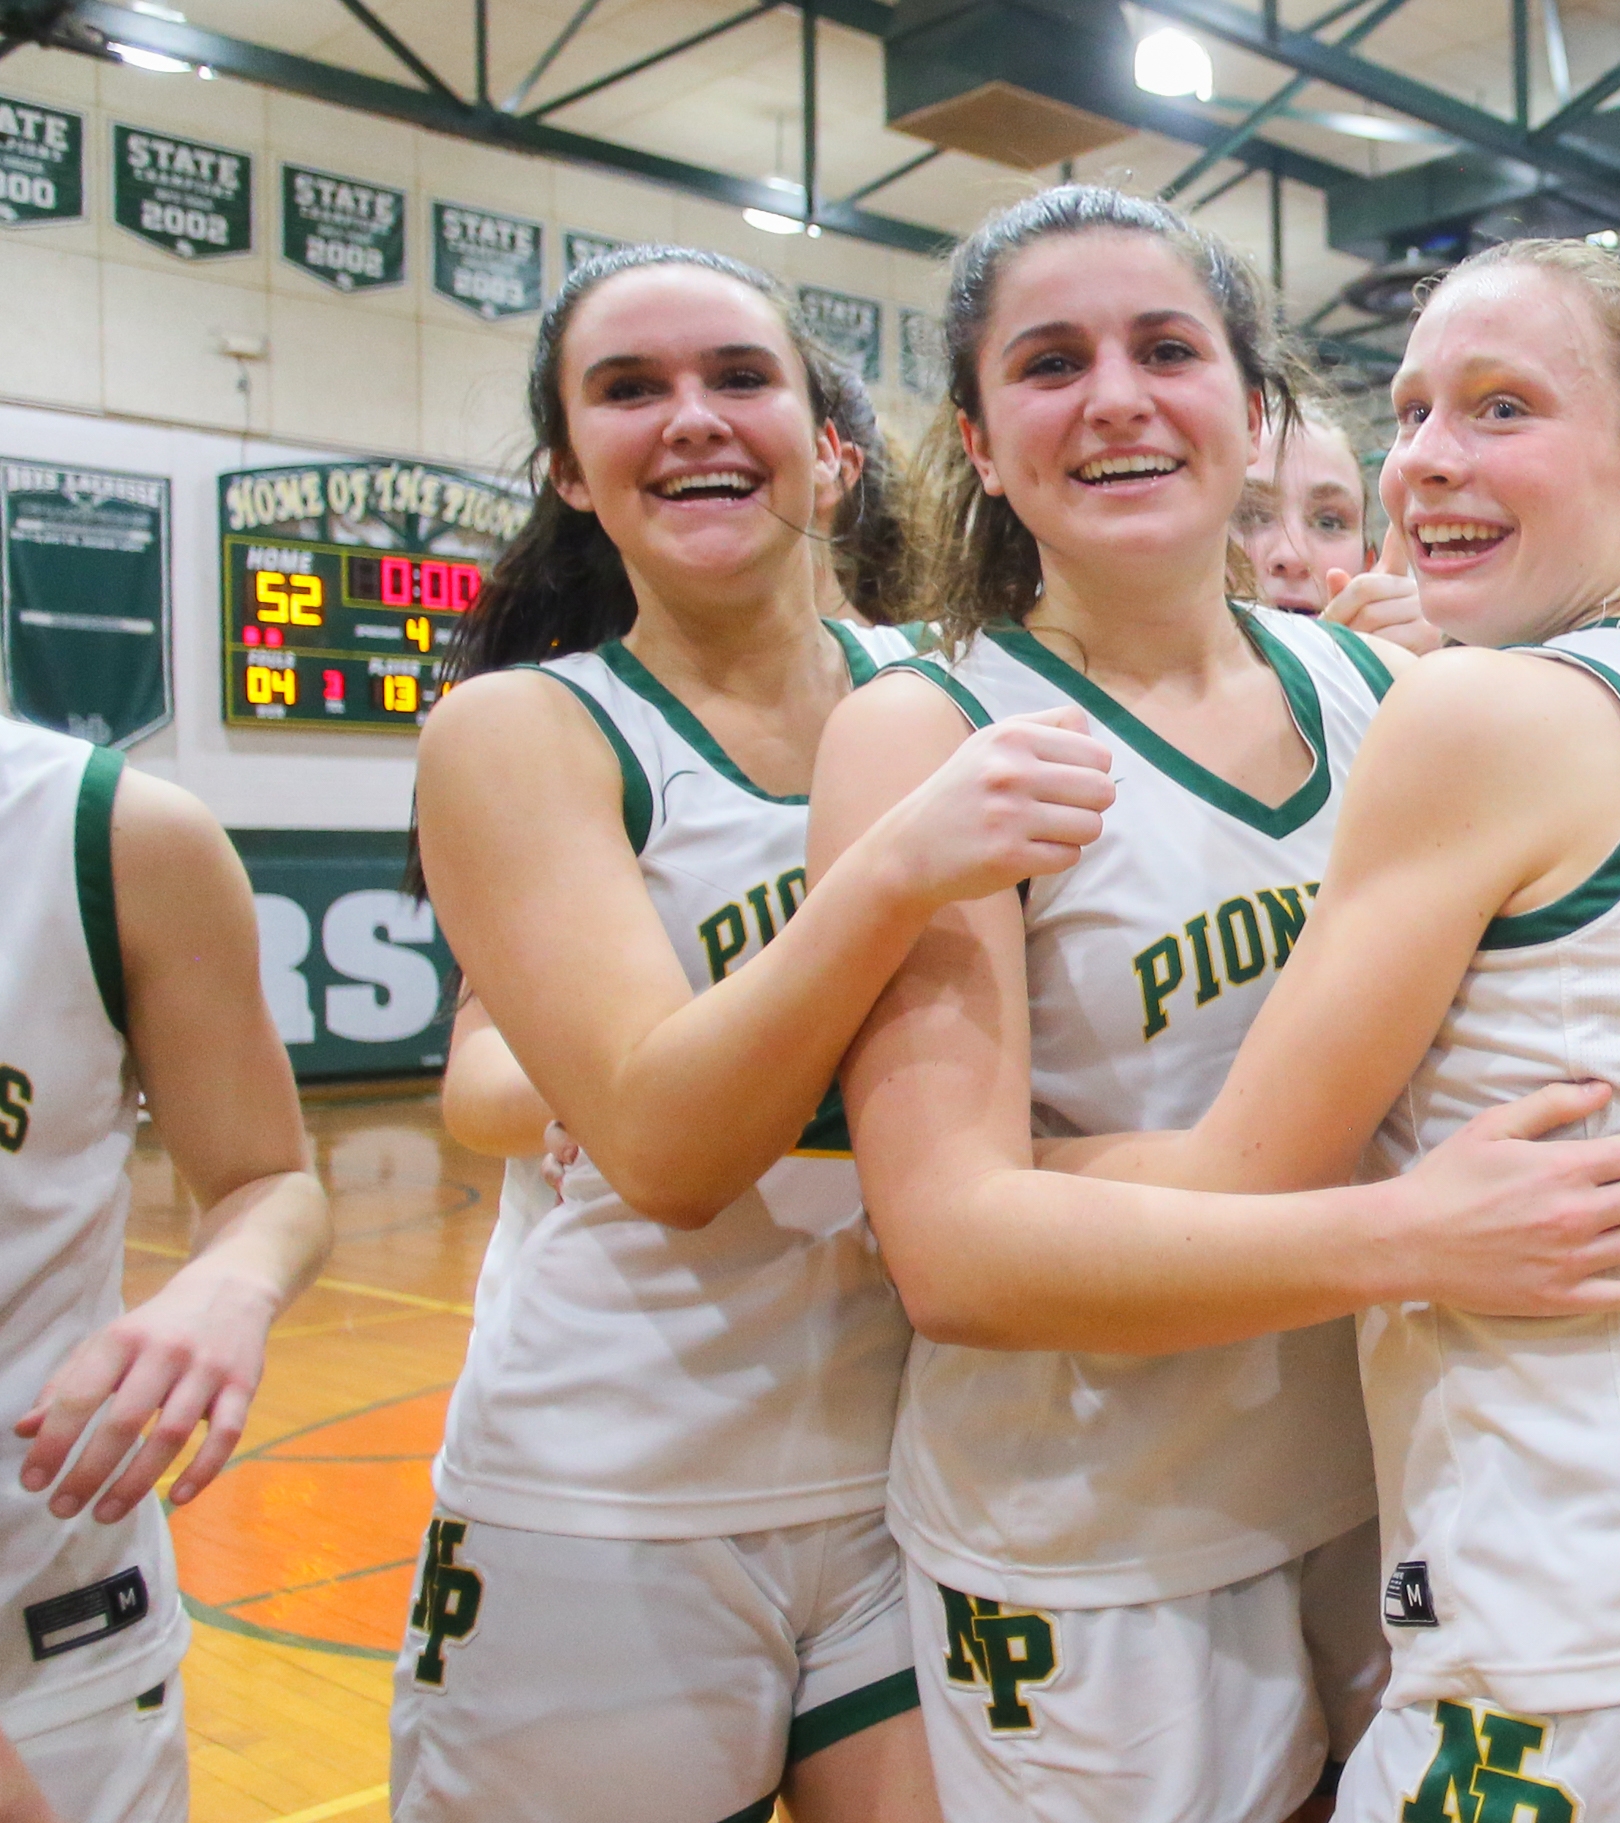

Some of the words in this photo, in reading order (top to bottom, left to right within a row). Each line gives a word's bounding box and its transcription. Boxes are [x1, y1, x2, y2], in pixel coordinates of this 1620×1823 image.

[127, 133, 240, 191] STATE
[0, 171, 57, 210] 00
[294, 172, 394, 226] STATE
[141, 199, 229, 246] 2002
[443, 208, 534, 258] STATE
[227, 471, 325, 530] HOME
[327, 468, 370, 522] OF
[374, 461, 441, 517] THE
[246, 547, 313, 574] HOME
[380, 555, 482, 612] 0:00
[255, 570, 323, 627] 52
[405, 616, 431, 653] 4
[246, 665, 296, 705] 04
[383, 674, 418, 713] 13
[1131, 880, 1321, 1043] PION
[118, 1587, 136, 1612] M
[1406, 1583, 1423, 1608] M
